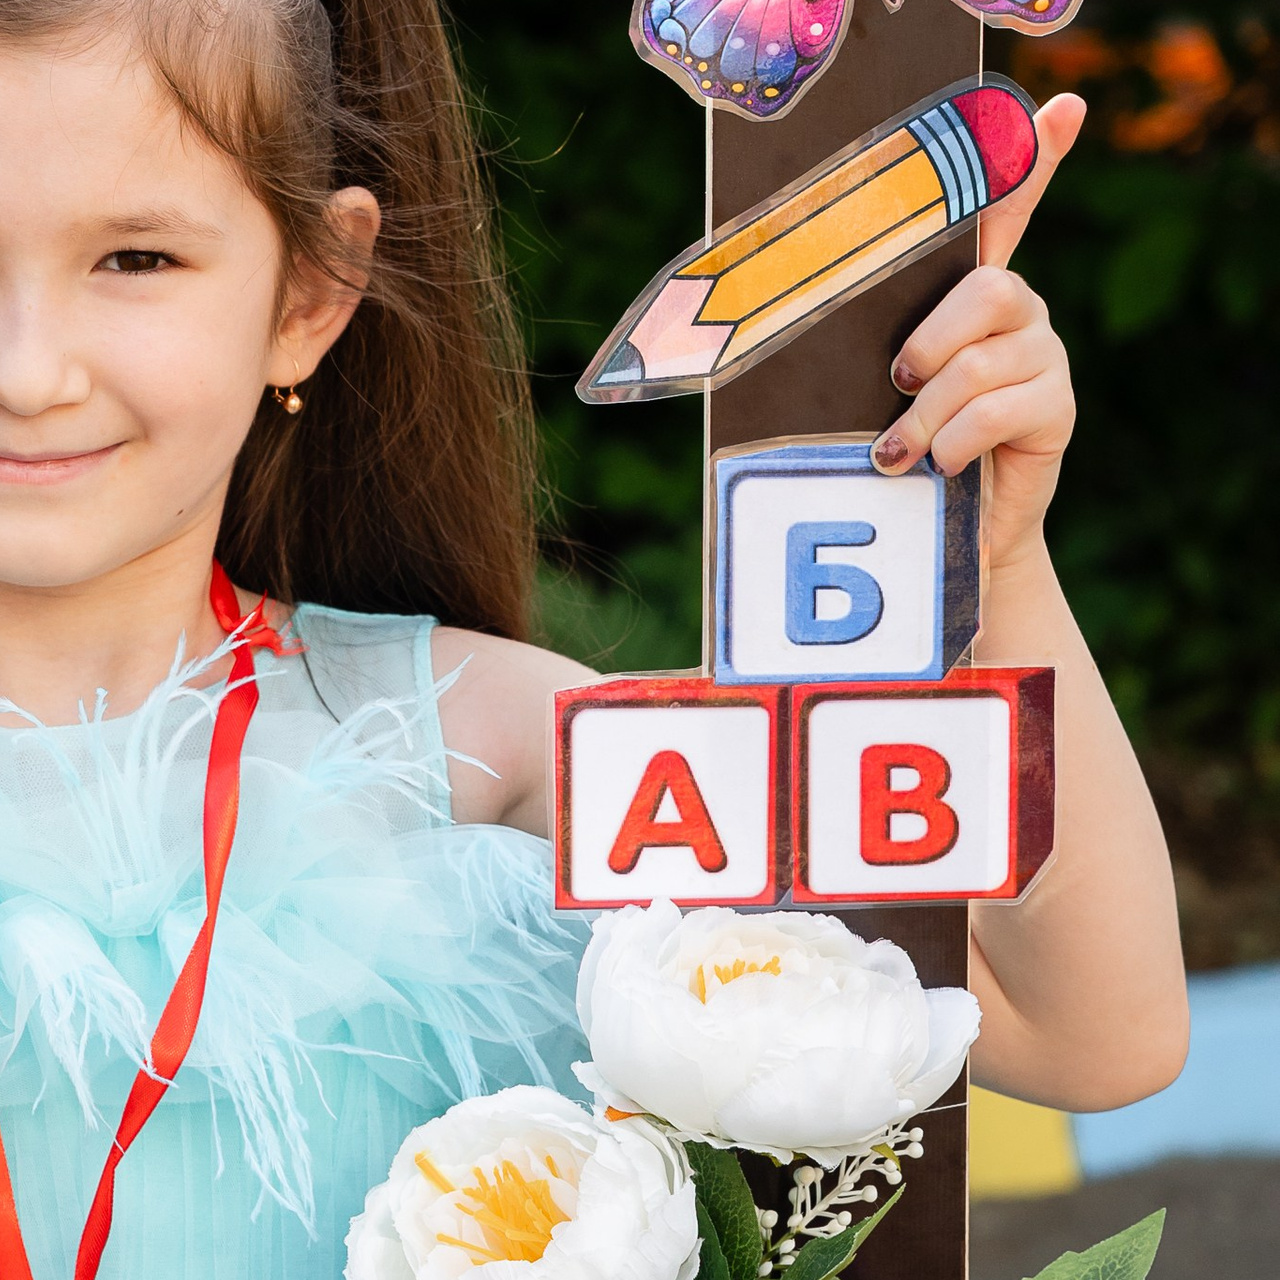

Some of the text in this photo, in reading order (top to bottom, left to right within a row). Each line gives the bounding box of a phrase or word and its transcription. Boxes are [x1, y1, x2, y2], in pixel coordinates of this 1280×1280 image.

[784, 520, 884, 646] Б
[607, 743, 959, 875] А В
